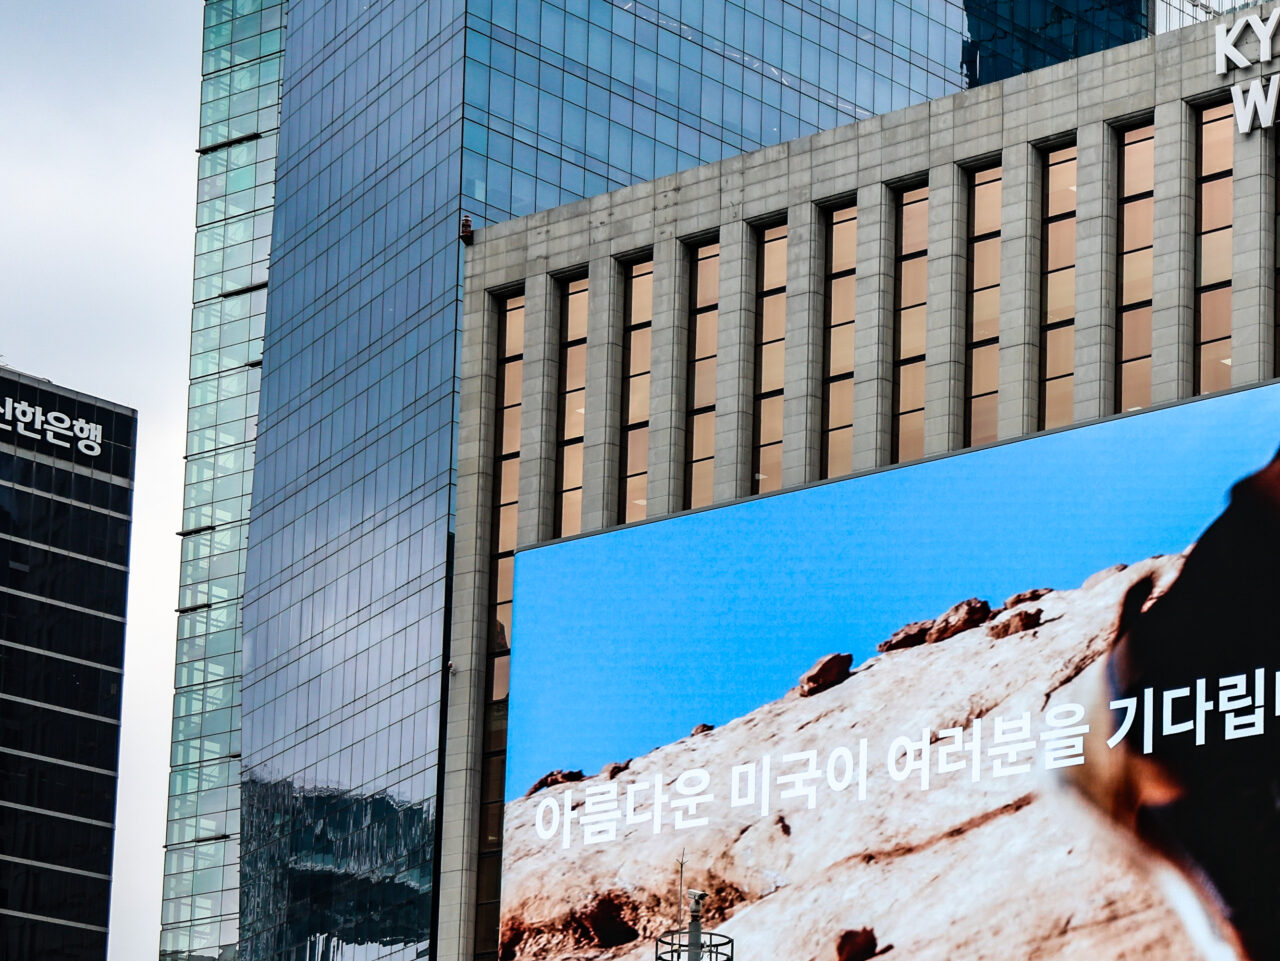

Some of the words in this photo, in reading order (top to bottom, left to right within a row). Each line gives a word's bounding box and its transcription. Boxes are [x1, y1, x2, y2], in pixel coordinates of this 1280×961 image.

[534, 768, 715, 849] 아름다운
[730, 737, 869, 817] 미국이
[887, 702, 1091, 791] 여러분을
